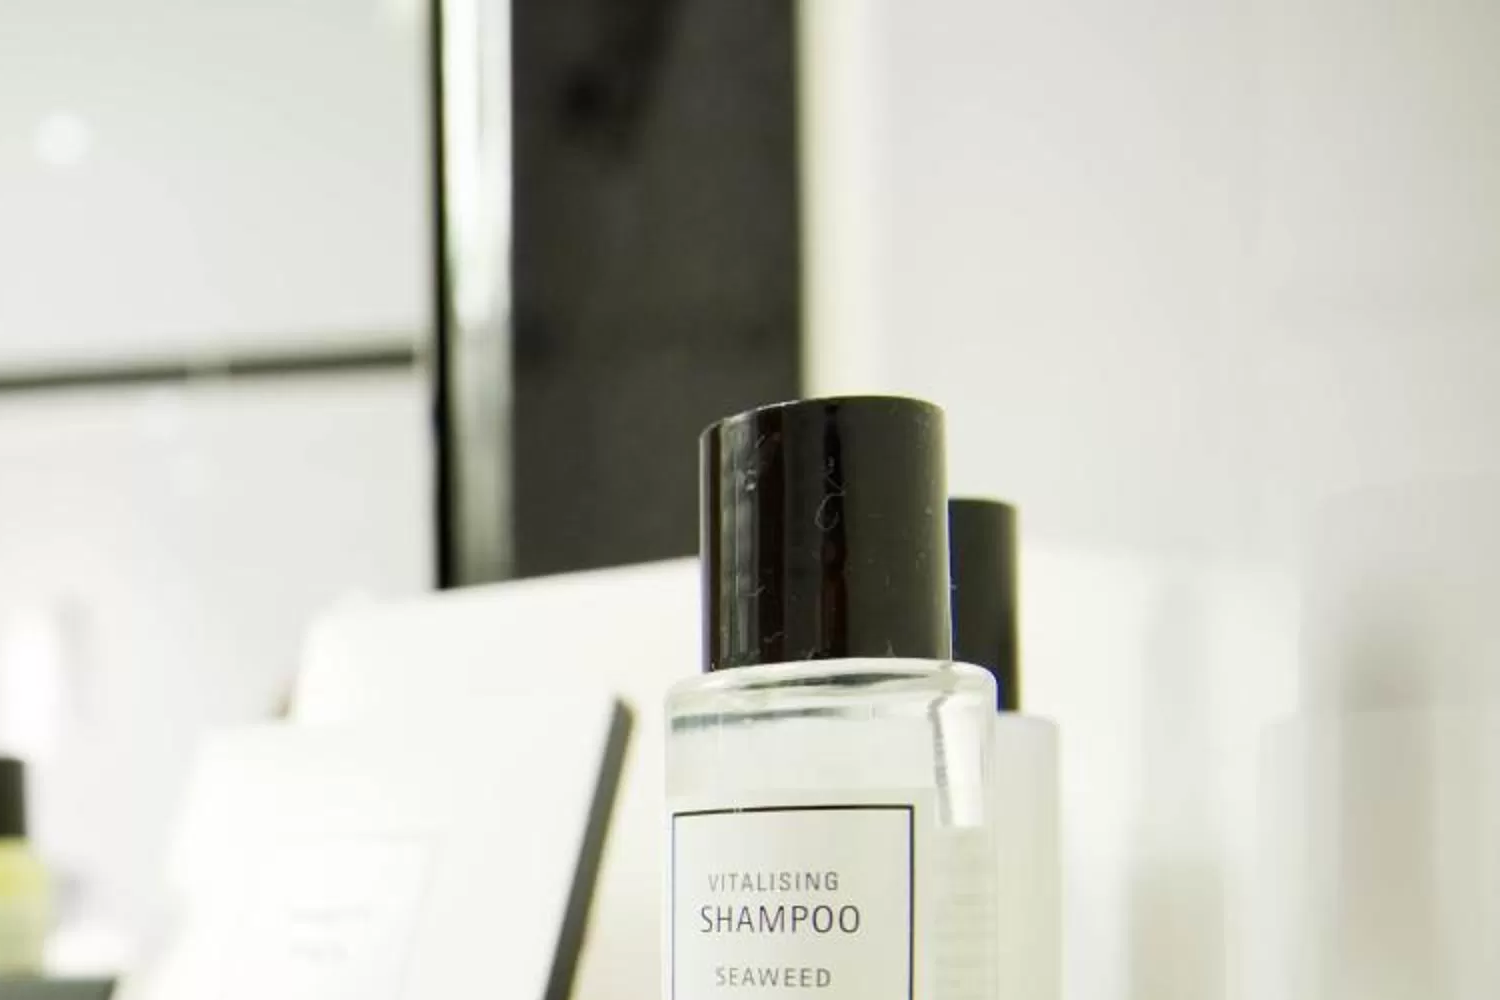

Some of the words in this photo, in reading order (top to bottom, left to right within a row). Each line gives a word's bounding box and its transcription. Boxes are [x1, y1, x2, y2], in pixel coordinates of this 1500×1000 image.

[707, 871, 841, 894] VITALISING
[699, 904, 862, 934] SHAMPOO
[715, 966, 832, 988] SEAWEED
